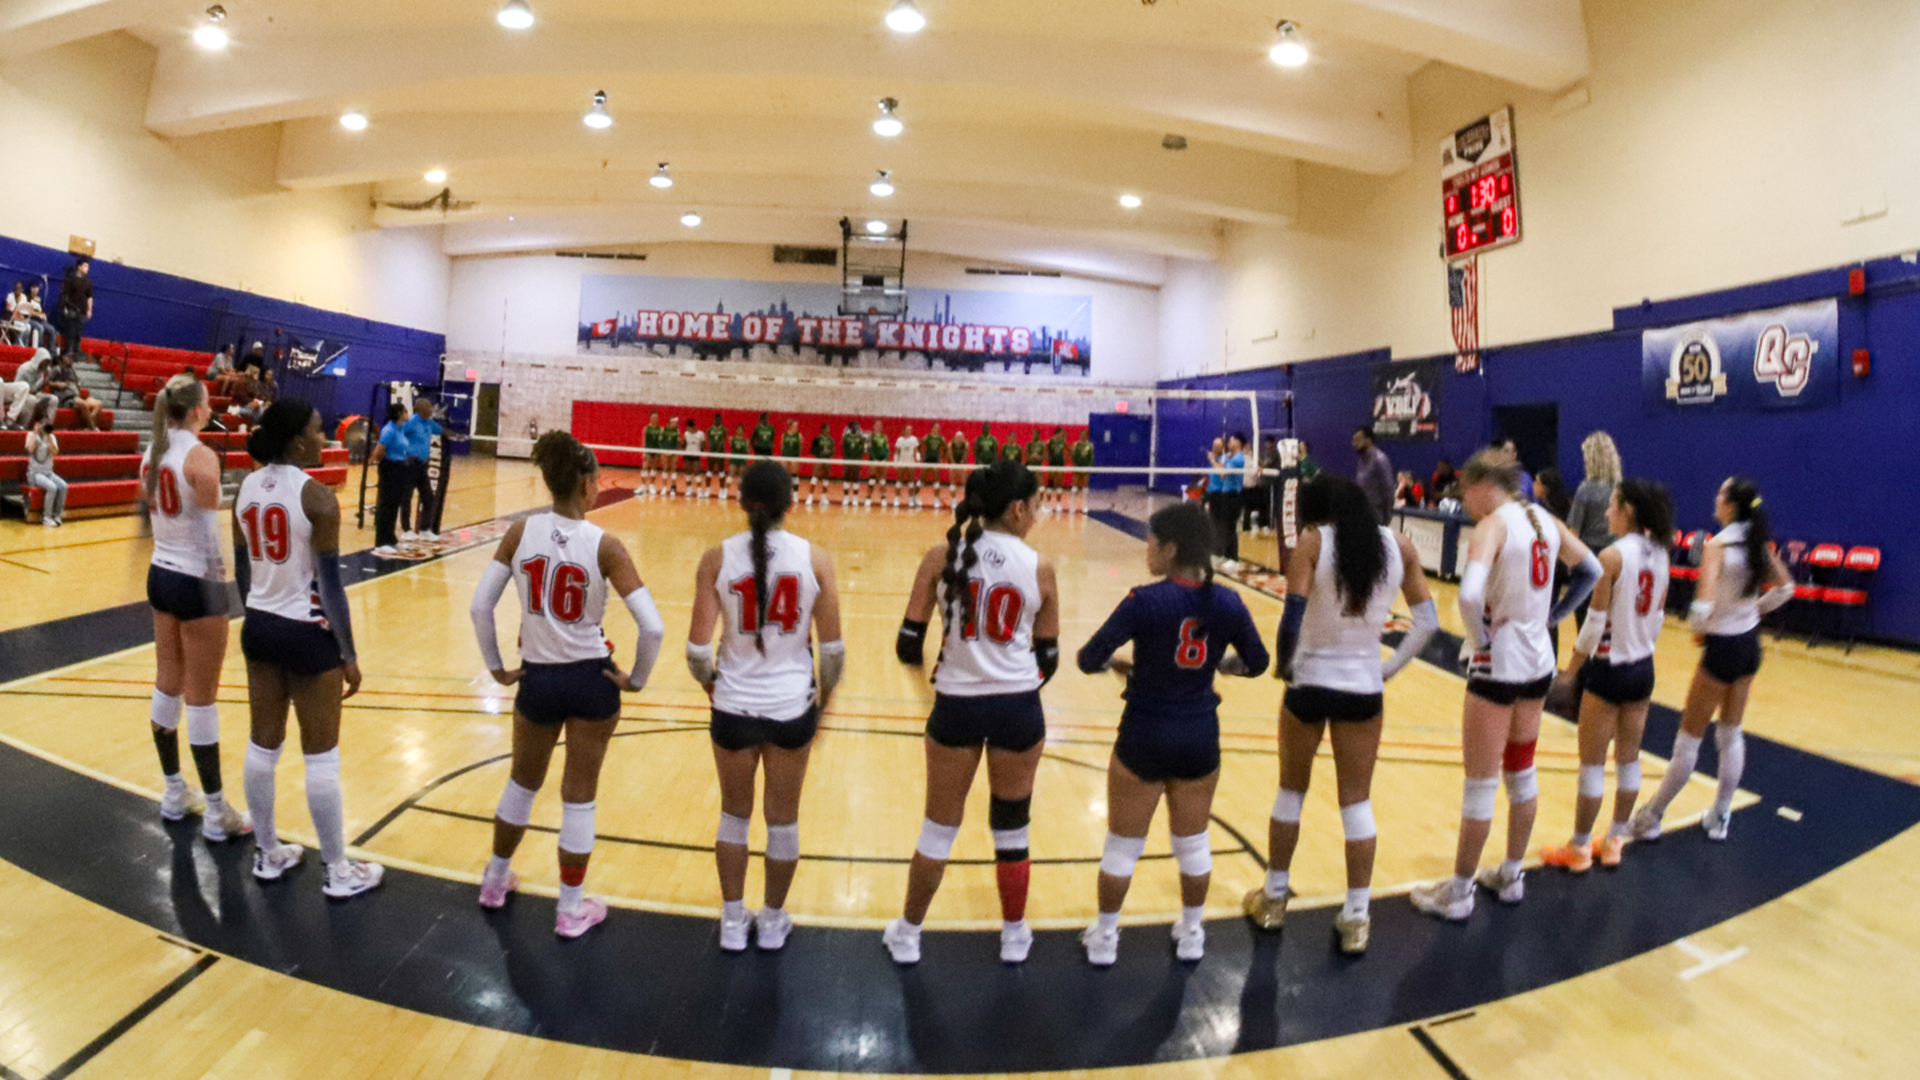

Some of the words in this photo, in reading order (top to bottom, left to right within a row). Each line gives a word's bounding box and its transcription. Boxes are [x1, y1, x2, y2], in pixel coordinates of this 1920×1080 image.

[1502, 206, 1514, 236] 0
[636, 309, 732, 341] HOME
[742, 315, 784, 342] OF
[796, 317, 865, 347] THE
[876, 320, 1032, 355] KNIGHTS
[1682, 352, 1709, 385] 50
[241, 502, 291, 564] 19
[521, 554, 589, 624] 16
[1529, 537, 1551, 591] 6
[728, 571, 803, 635] 14
[957, 576, 1026, 647] 10
[1635, 568, 1655, 617] 3
